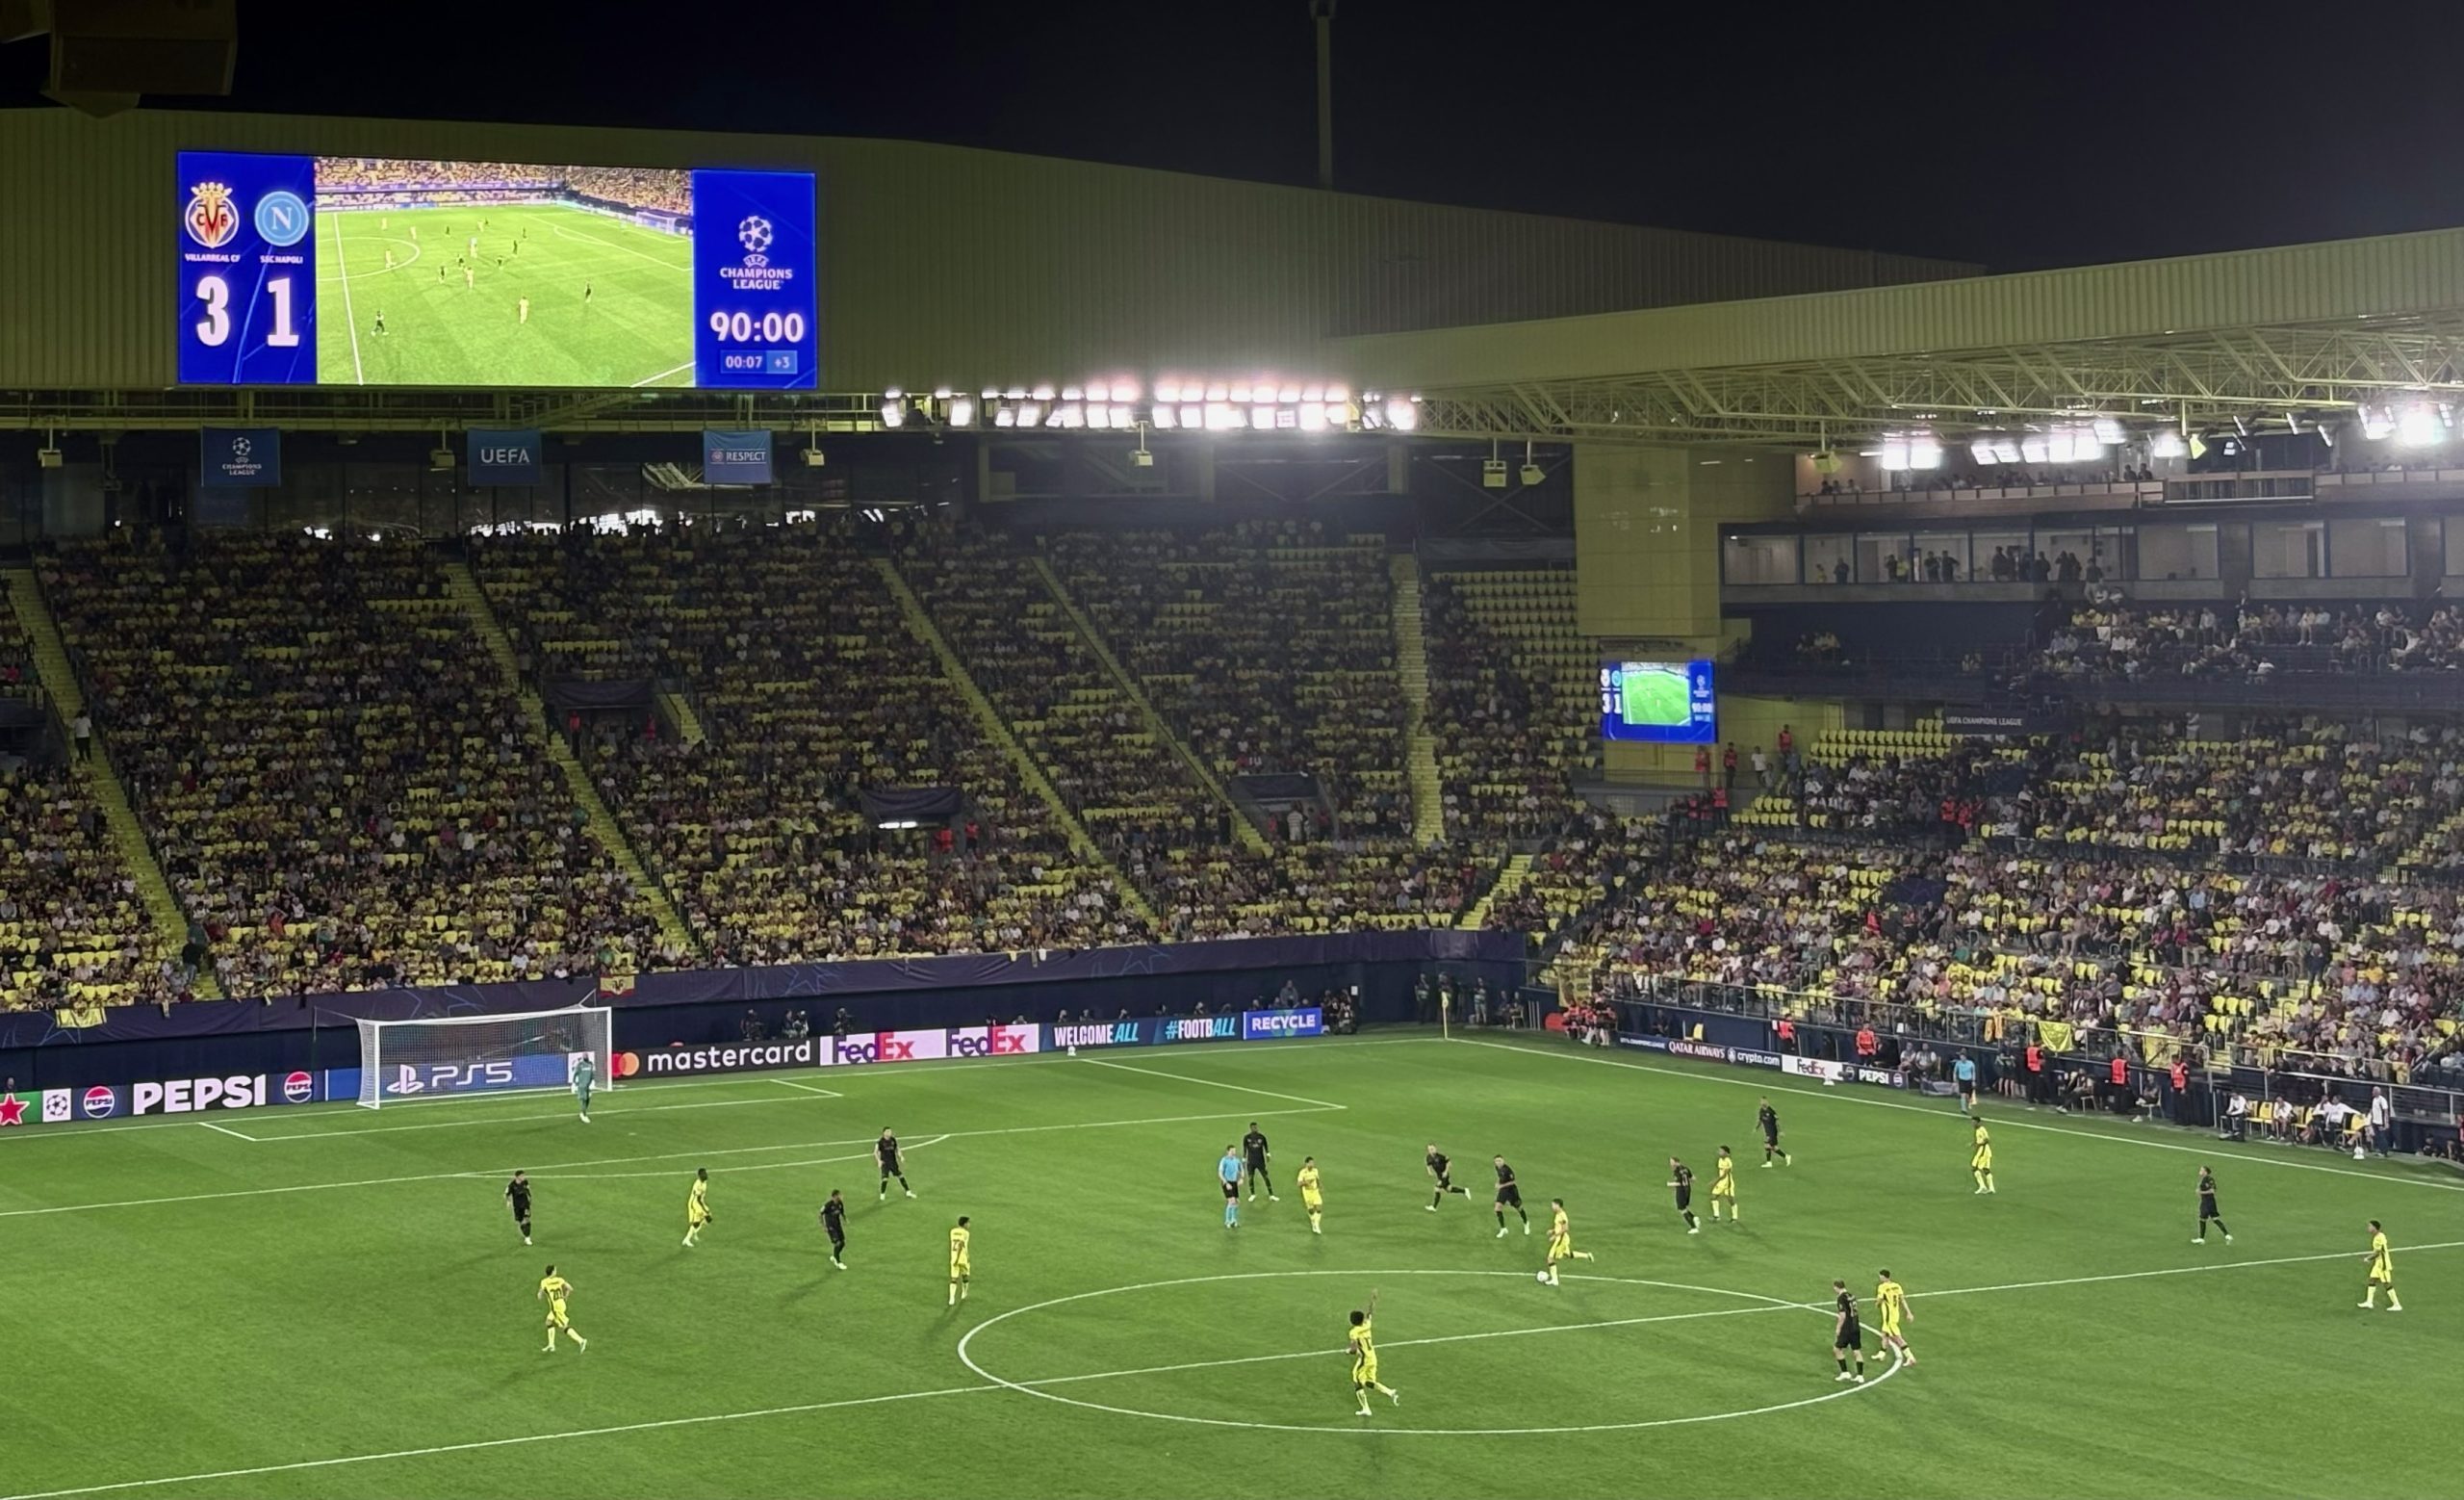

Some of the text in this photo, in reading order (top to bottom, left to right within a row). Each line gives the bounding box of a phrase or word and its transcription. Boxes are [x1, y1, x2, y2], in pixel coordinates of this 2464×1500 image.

[720, 268, 793, 279] CHAMPIONS
[732, 279, 782, 290] LEAGUE
[196, 275, 230, 348] 3
[267, 277, 299, 348] 1
[709, 311, 805, 343] 90:00
[725, 355, 763, 369] 00:07
[774, 356, 790, 369] +3
[481, 448, 530, 464] UEFA
[725, 451, 767, 463] RESPECT
[1602, 692, 1611, 714] 3
[1613, 694, 1623, 714] 1
[1963, 716, 1997, 726] CHAMPIONS
[1998, 717, 2023, 727] LEAGUE
[1165, 1017, 1236, 1040] #FOOTBALL
[1251, 1013, 1316, 1032] RECYCLE
[945, 1025, 1026, 1058] FedEx
[1054, 1022, 1139, 1047] WELCOME ALL
[647, 1040, 810, 1073] mastercard
[833, 1031, 915, 1064] FedEx
[1669, 1041, 1726, 1059] QATAR AIRWAYS
[1737, 1052, 1781, 1067] crypto.com
[1797, 1058, 1826, 1076] FedEx
[431, 1061, 513, 1086] PS5
[1859, 1068, 1889, 1085] PEPSI
[86, 1098, 114, 1107] PEPSI
[133, 1073, 267, 1115] PEPSI
